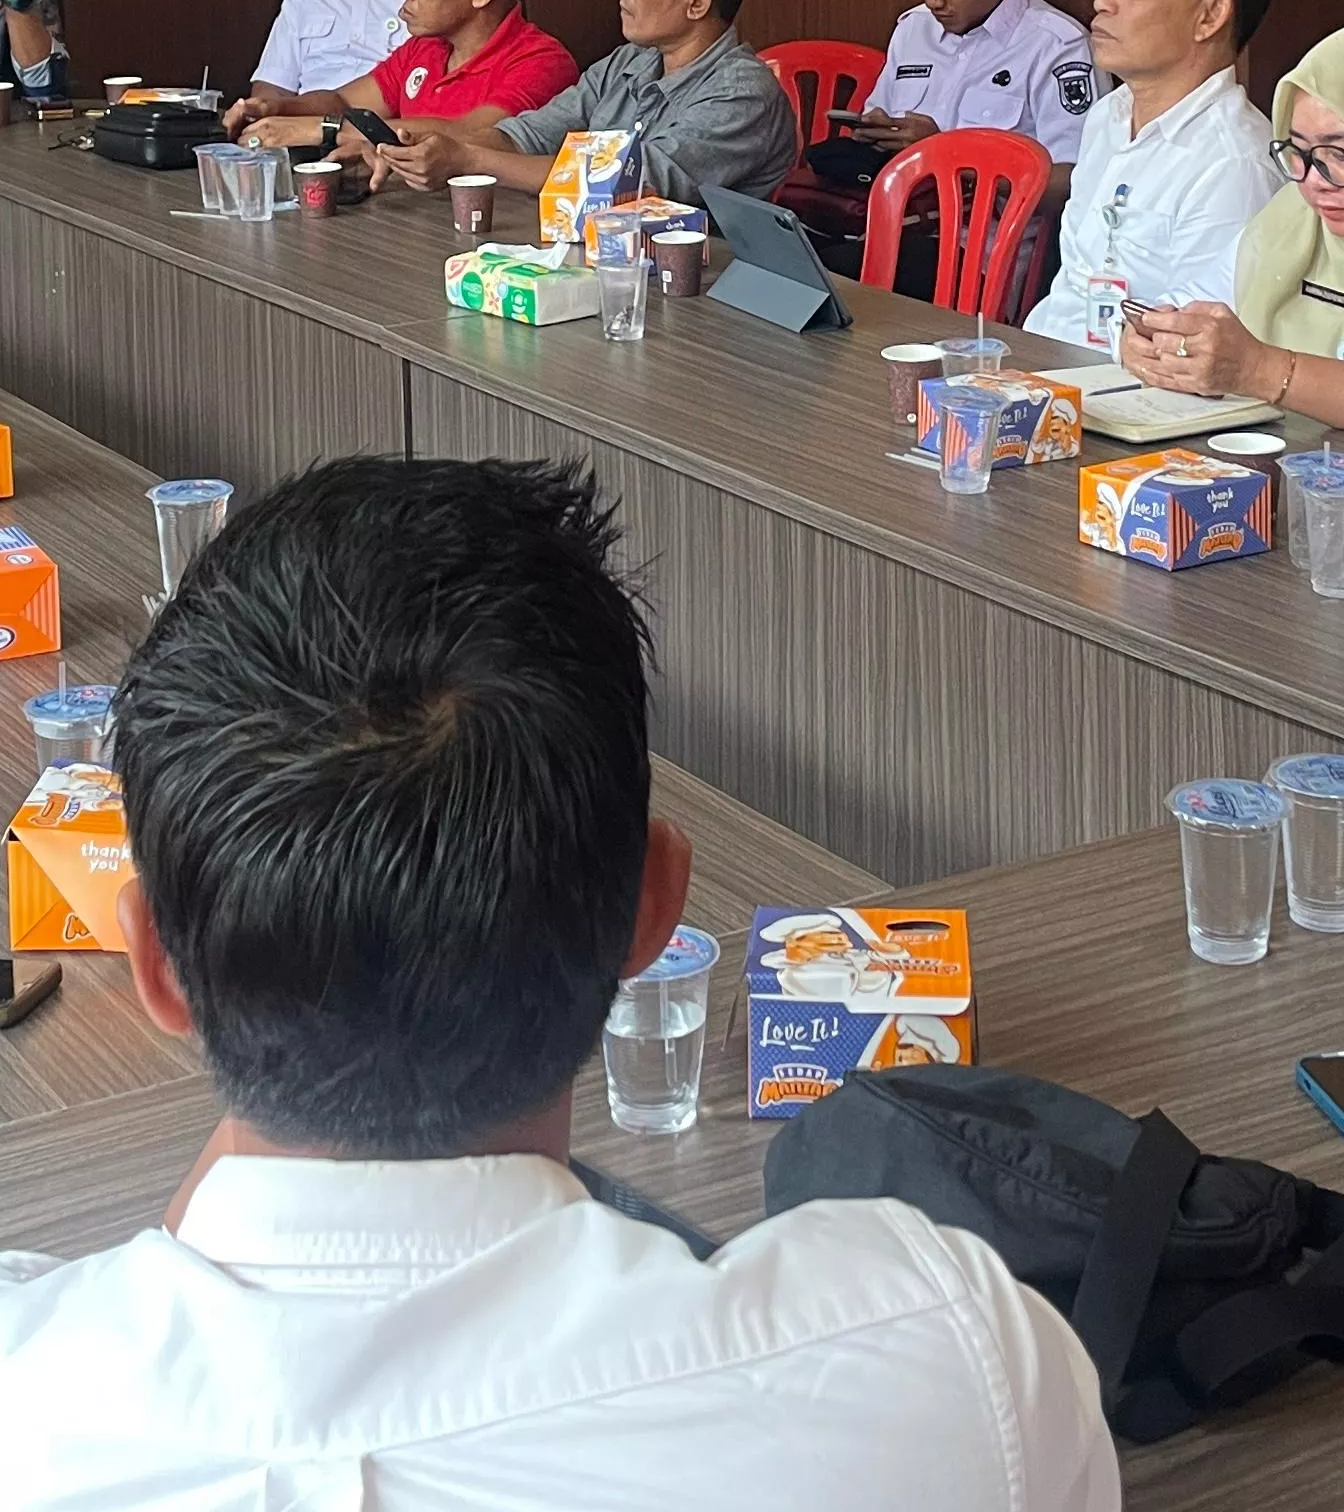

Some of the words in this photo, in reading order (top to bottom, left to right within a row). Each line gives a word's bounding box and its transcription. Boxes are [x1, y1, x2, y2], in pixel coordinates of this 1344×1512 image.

[80, 840, 131, 860] thank
[89, 859, 118, 873] you
[759, 1015, 807, 1048] Love
